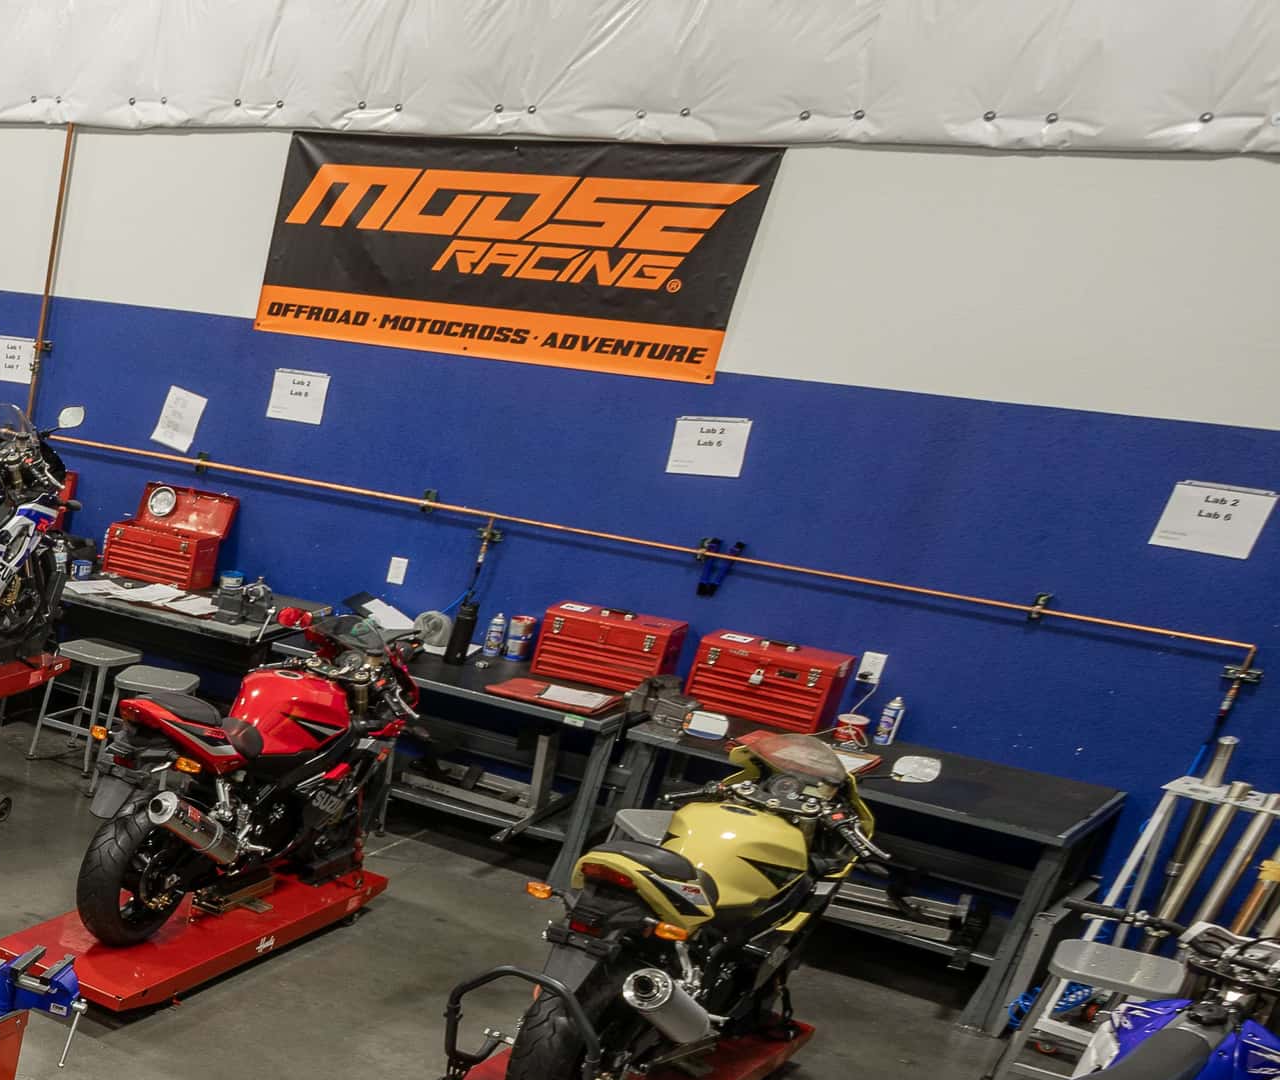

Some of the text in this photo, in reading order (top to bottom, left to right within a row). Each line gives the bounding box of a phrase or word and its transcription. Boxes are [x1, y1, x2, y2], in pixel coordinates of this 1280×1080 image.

[285, 163, 761, 253] MOOSE
[267, 301, 708, 365] OFFROAD MOTOCROSS ADVENTURE
[290, 389, 302, 397] Lab
[1204, 495, 1240, 507] Lab 2
[1197, 509, 1232, 521] Lab 6
